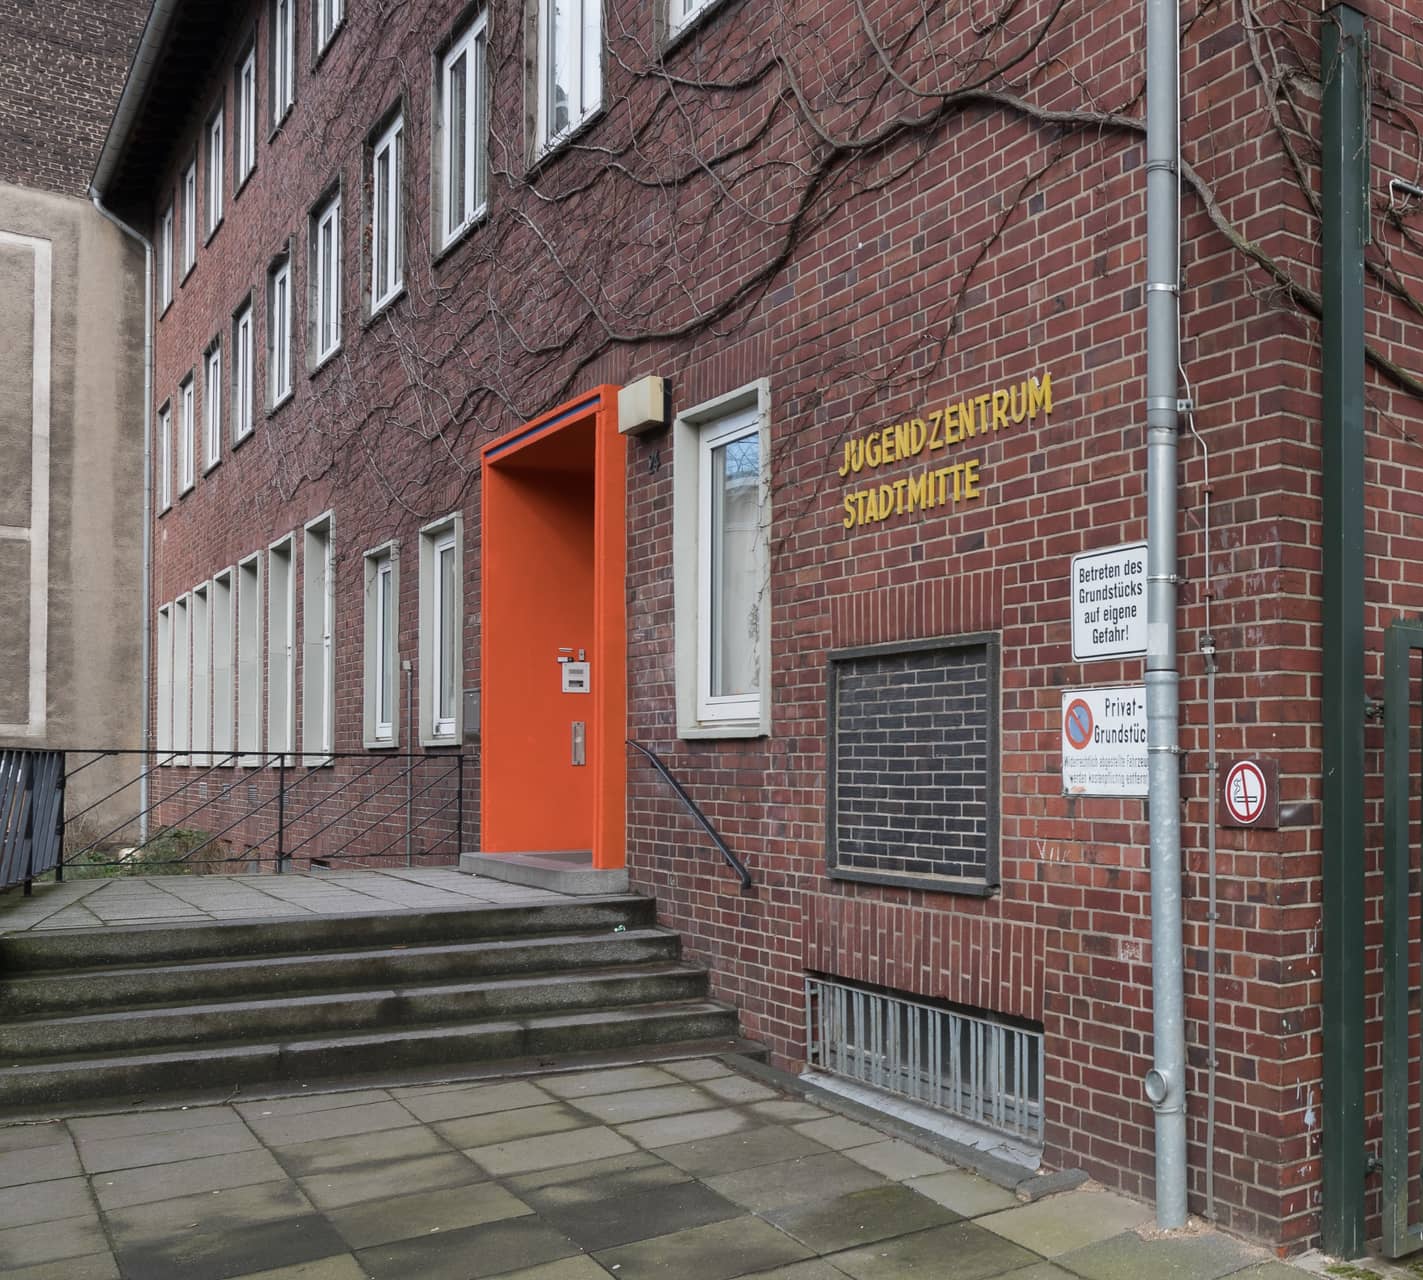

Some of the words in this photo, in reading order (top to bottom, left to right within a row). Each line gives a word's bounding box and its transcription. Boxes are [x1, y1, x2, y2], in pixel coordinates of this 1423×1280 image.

[838, 372, 1053, 477] JUGENDZENTRUM
[843, 459, 980, 529] STADTMITTE
[1079, 563, 1121, 583] Betreten
[1123, 560, 1143, 576] des
[1079, 581, 1143, 604] Grundstücks
[1084, 607, 1100, 624] auf
[1103, 604, 1137, 625] eigene
[1092, 625, 1129, 644] Gefahr!
[1105, 697, 1143, 717] Privat-
[1094, 723, 1147, 744] Grundstüc
